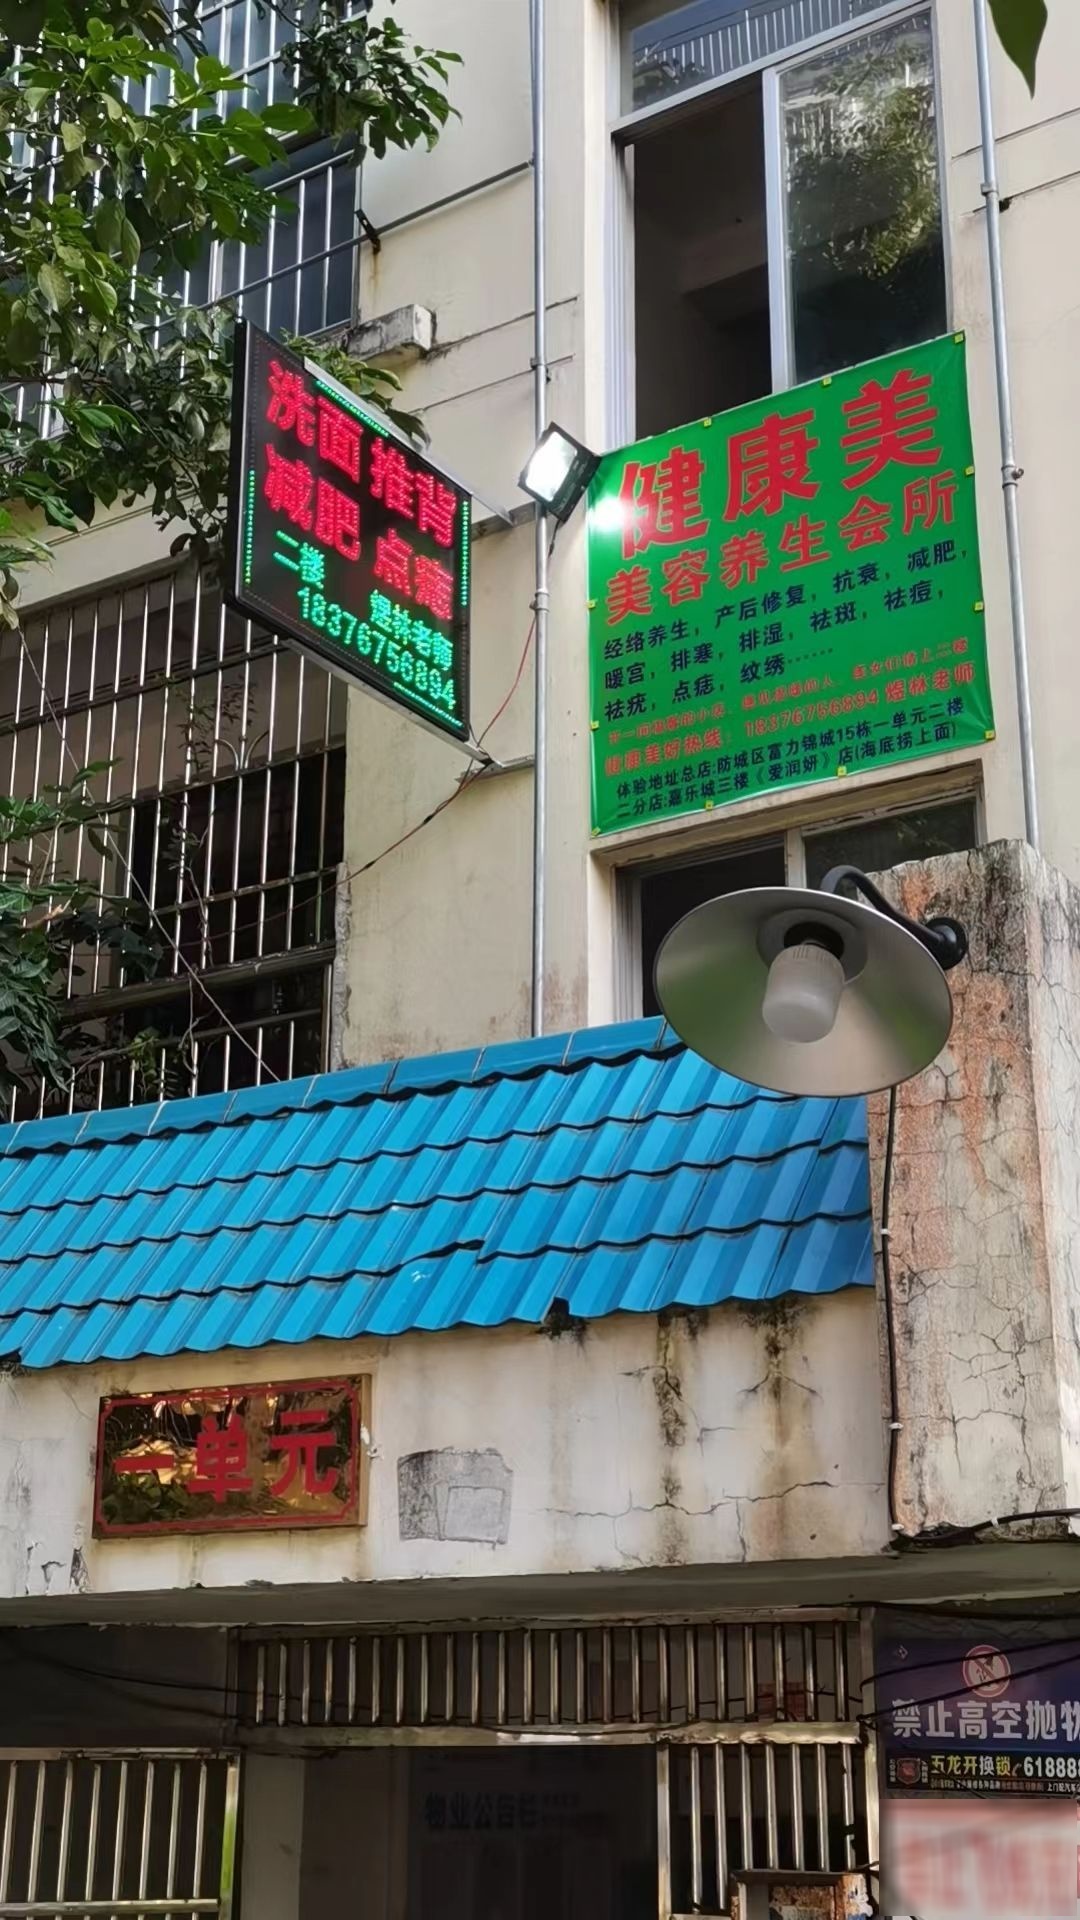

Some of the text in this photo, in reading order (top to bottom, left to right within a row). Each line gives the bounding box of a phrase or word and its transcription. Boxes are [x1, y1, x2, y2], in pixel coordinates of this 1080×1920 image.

[264, 444, 362, 561] 减肥
[266, 360, 457, 548] 洗面 推背
[619, 368, 944, 561] 健康美
[274, 530, 325, 589] 二楼
[606, 467, 959, 626] 美容养生会所
[297, 587, 456, 709] 18376756894
[745, 687, 878, 737] 18376756894
[884, 659, 976, 705] 煜林老师
[114, 1410, 337, 1503] 一单元
[891, 1698, 1080, 1742] 禁止高空抛物
[931, 1755, 1011, 1776] 五龙开换锁
[1023, 1756, 1080, 1778] 61888
